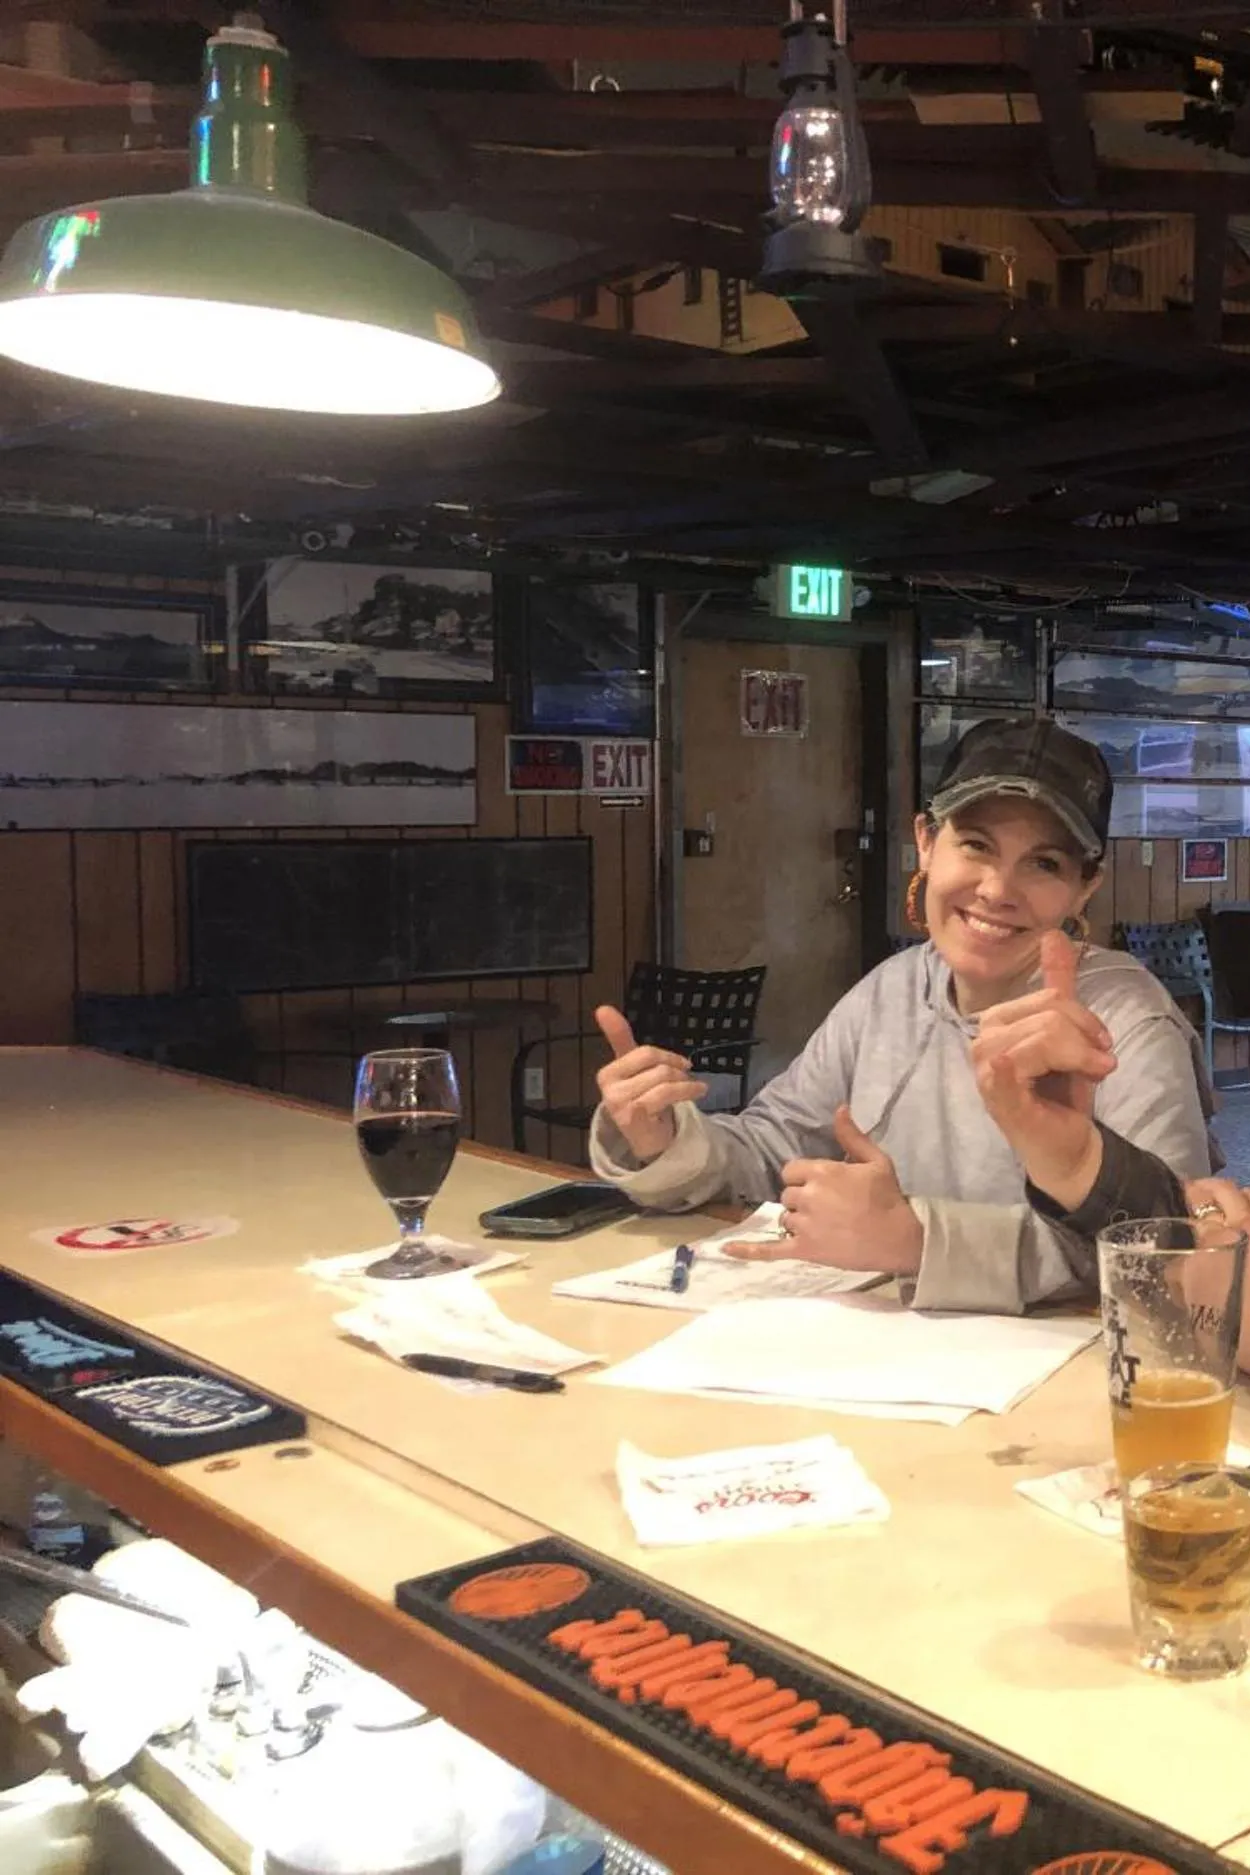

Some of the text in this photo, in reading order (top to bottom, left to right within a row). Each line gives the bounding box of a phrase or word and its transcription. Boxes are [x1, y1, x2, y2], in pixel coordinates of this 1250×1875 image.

[791, 566, 843, 616] EXIT
[746, 677, 804, 731] EXIT
[593, 745, 647, 787] EXIT
